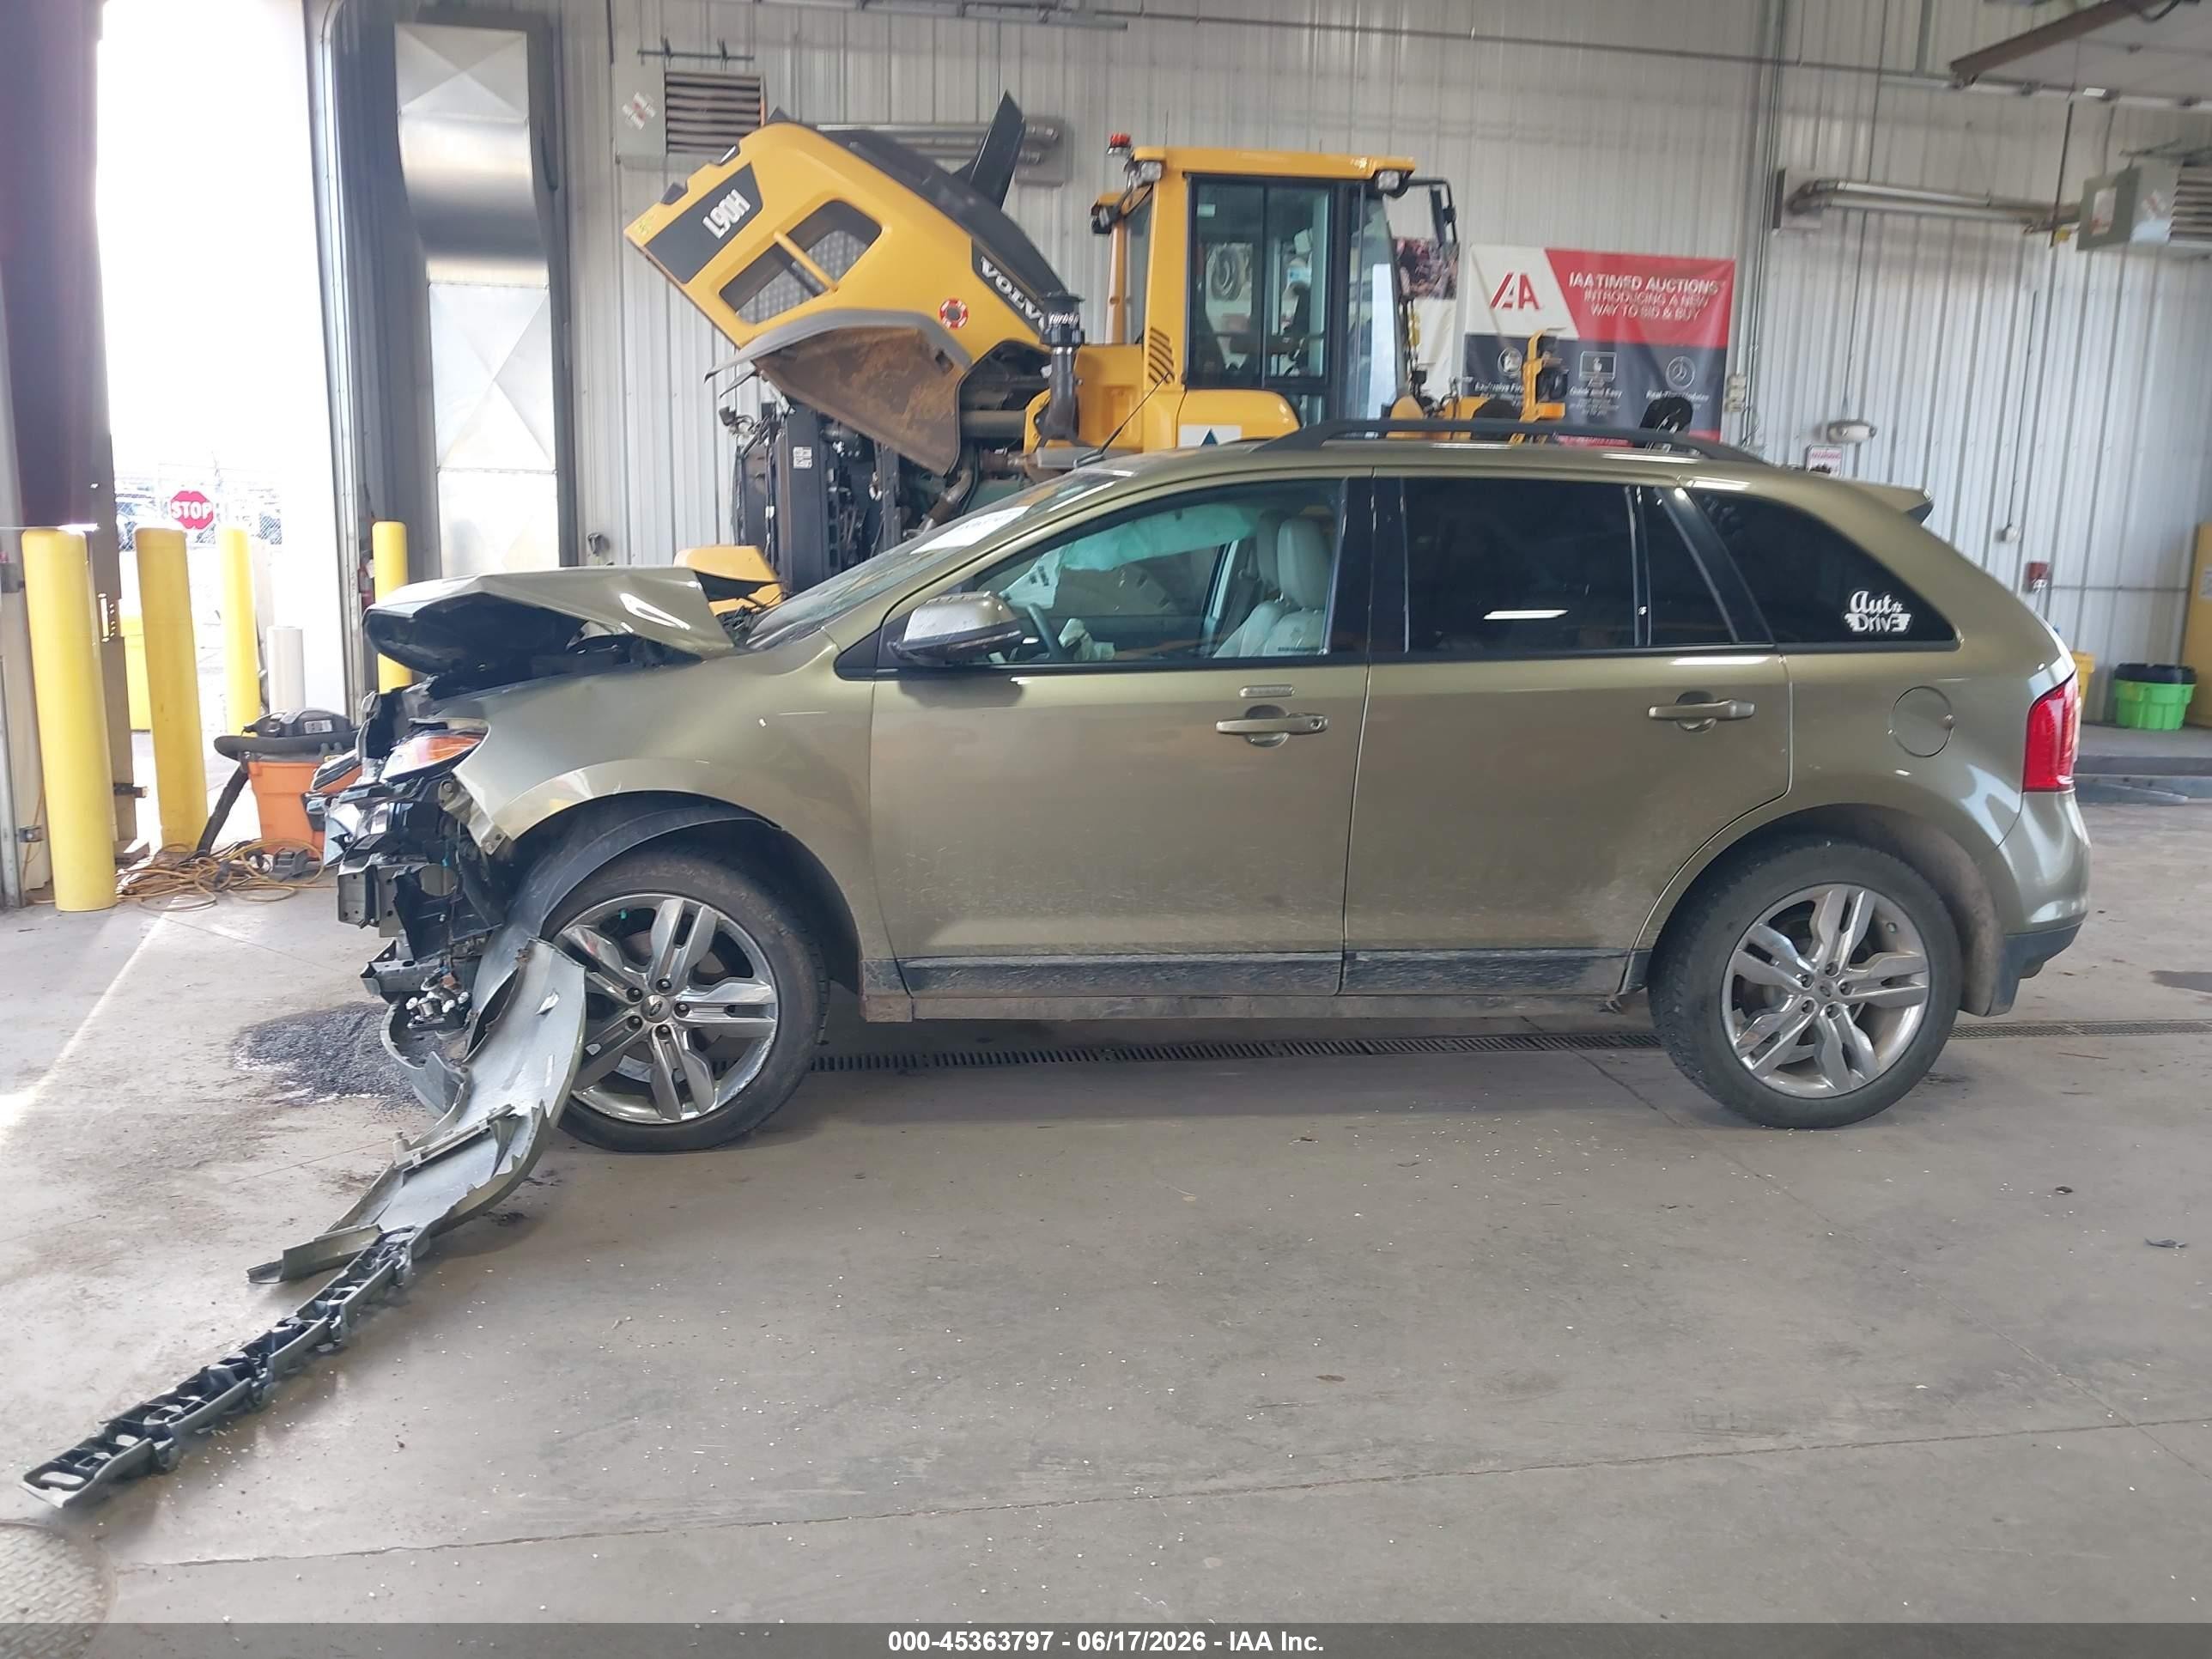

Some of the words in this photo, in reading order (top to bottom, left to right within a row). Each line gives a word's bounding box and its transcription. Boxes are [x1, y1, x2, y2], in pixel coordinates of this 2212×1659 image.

[702, 188, 750, 239] L90H
[981, 256, 1045, 331] VOLV
[1568, 271, 1595, 288] IAA
[1596, 273, 1643, 291] TIMED
[1644, 276, 1719, 295] AUCTIONS
[172, 501, 214, 520] STOP
